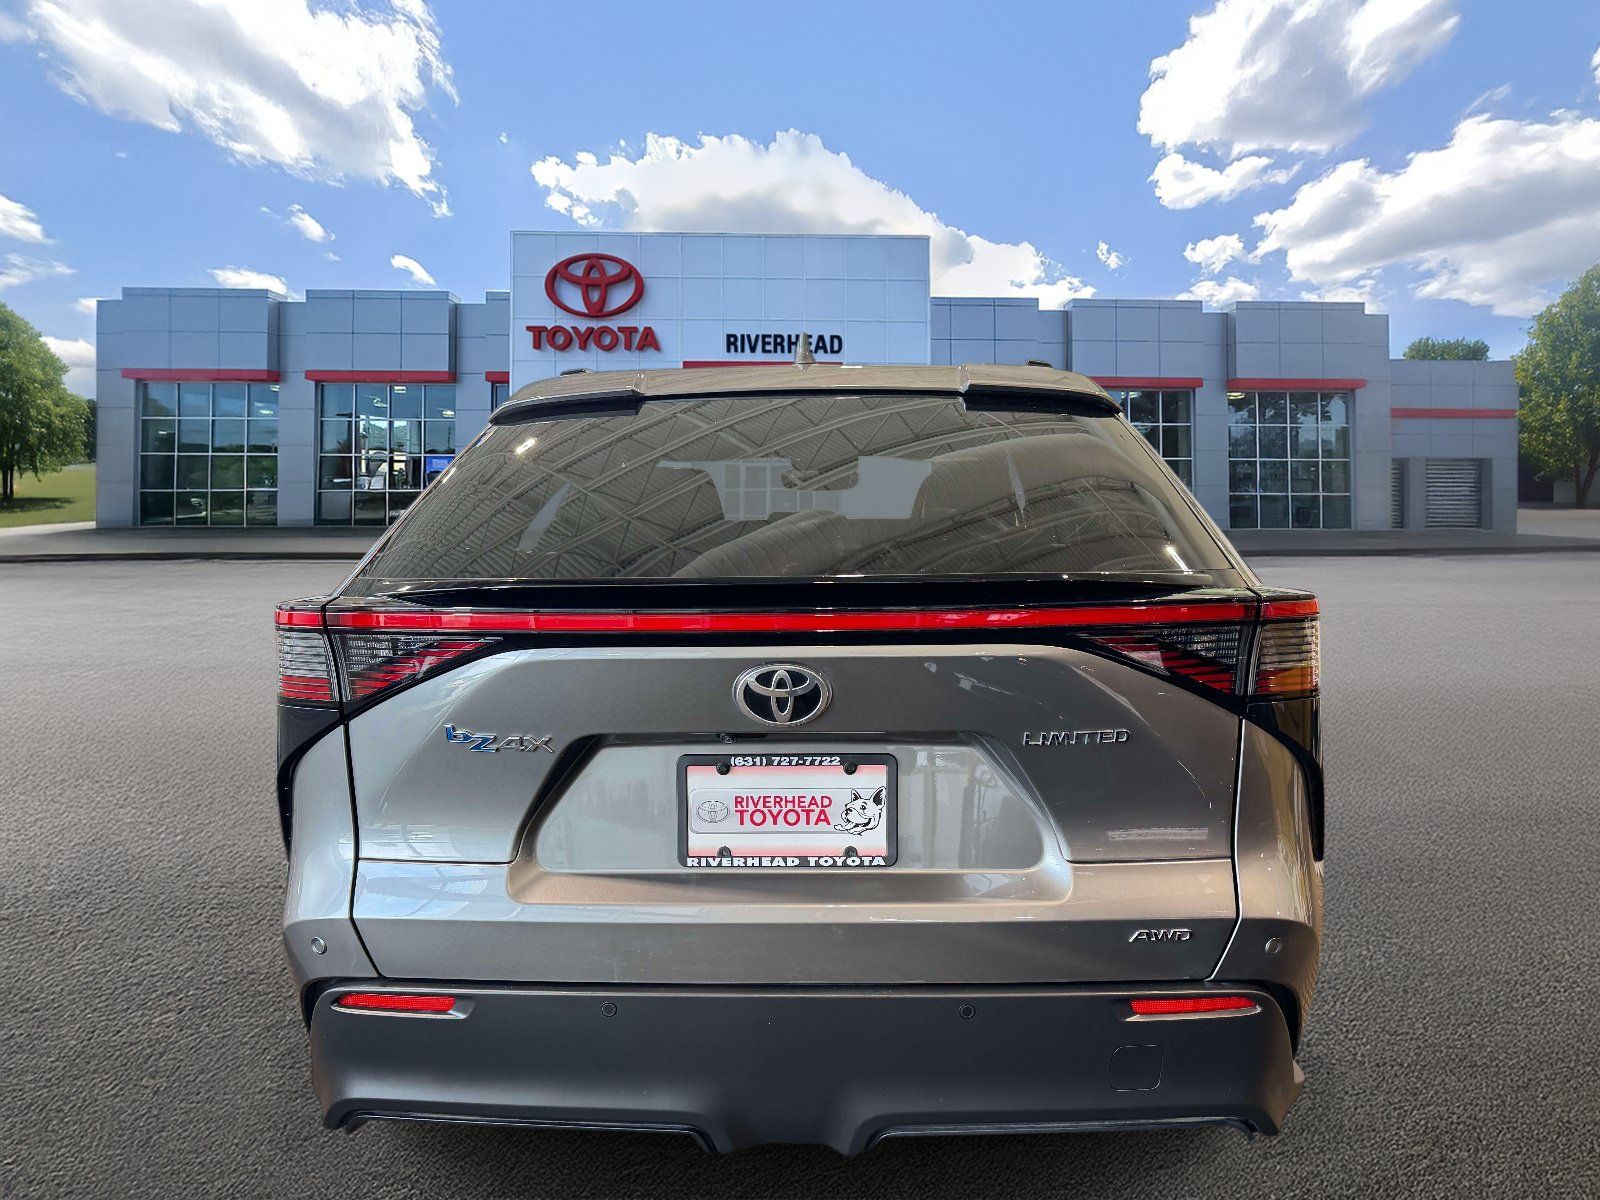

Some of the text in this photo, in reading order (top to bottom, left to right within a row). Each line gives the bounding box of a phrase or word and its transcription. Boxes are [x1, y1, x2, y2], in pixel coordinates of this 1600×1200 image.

[526, 326, 661, 352] TOYOTA
[1022, 729, 1131, 746] LIMITED
[730, 756, 841, 766] (631) 727-7722
[734, 796, 832, 808] RIVERHEAD
[735, 809, 831, 826] TOYOTA
[687, 857, 886, 867] RIVERHEAD TOYOTA
[1128, 928, 1192, 943] AWD
